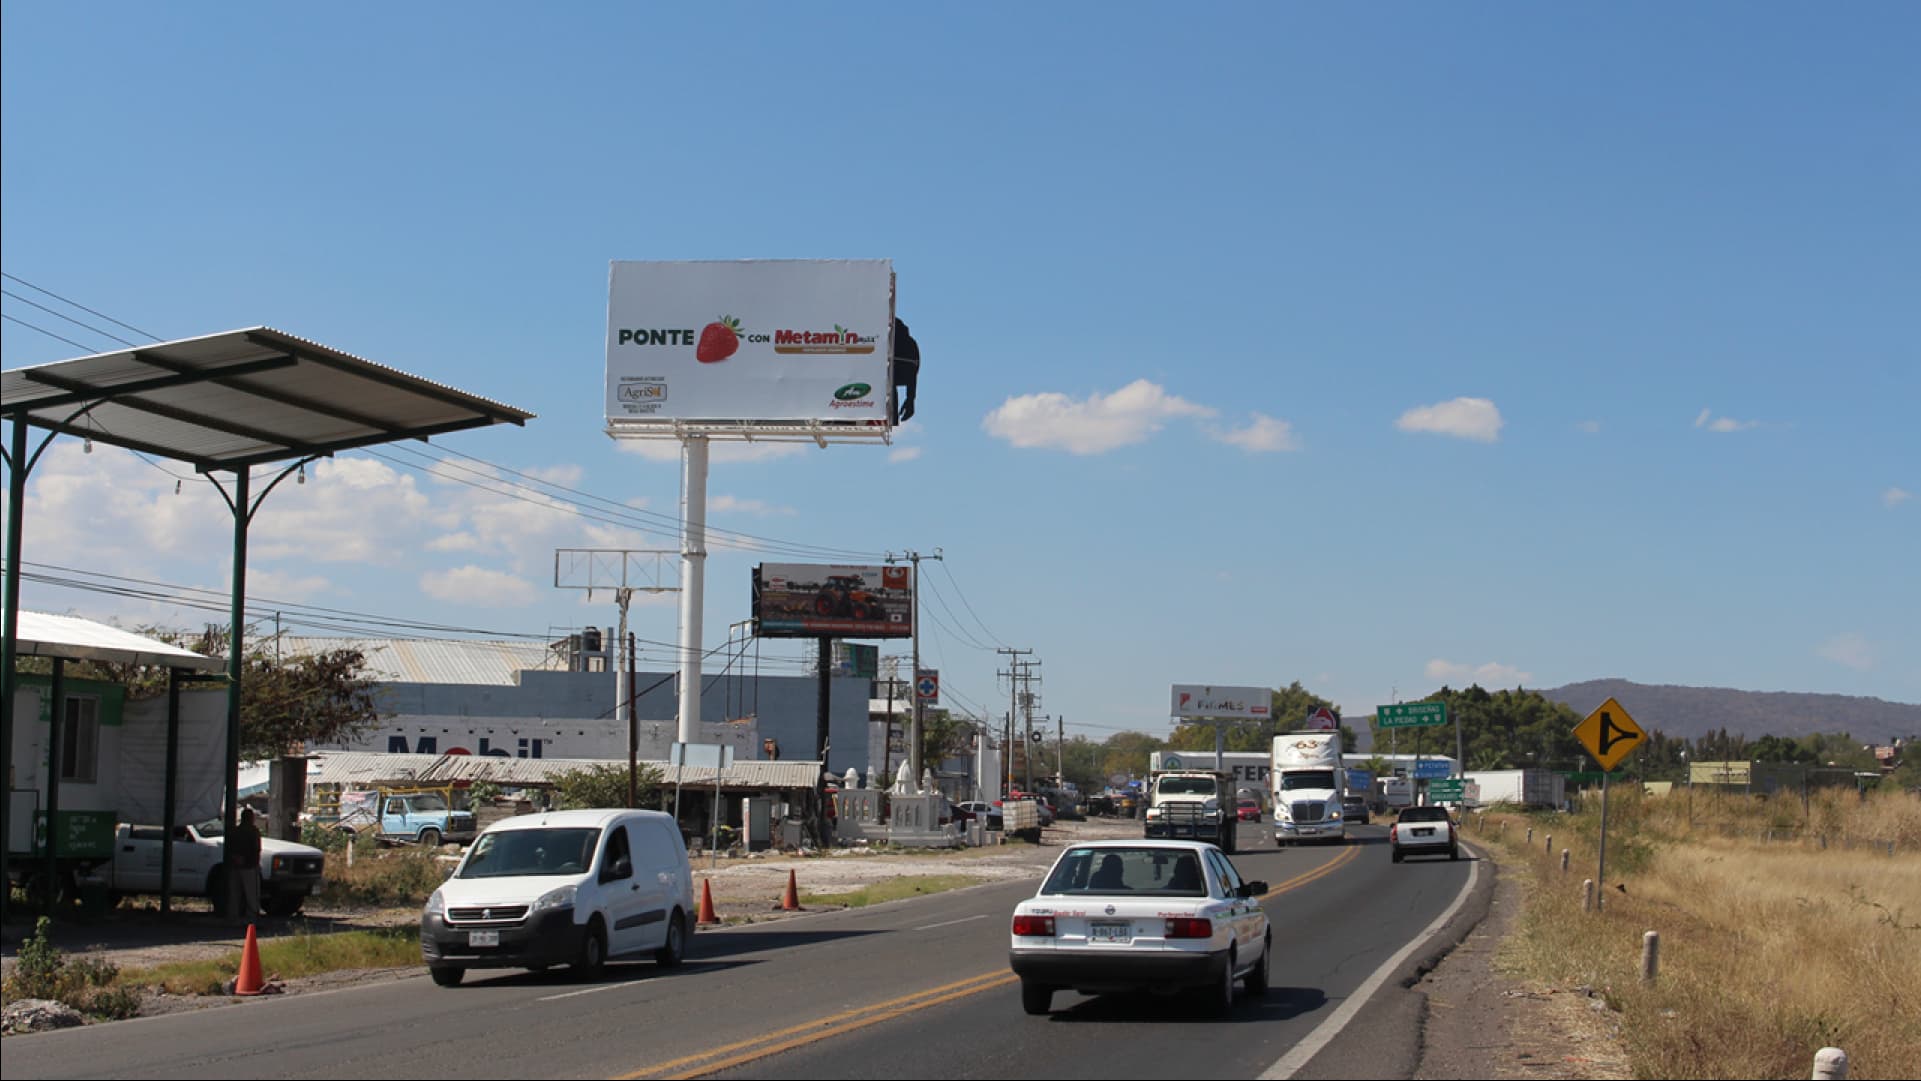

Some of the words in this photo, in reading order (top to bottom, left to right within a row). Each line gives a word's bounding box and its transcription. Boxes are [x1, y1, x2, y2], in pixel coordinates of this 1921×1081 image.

[618, 329, 694, 345] PONTE
[748, 335, 770, 343] CON
[774, 327, 858, 345] Metamin
[1384, 717, 1393, 725] LA
